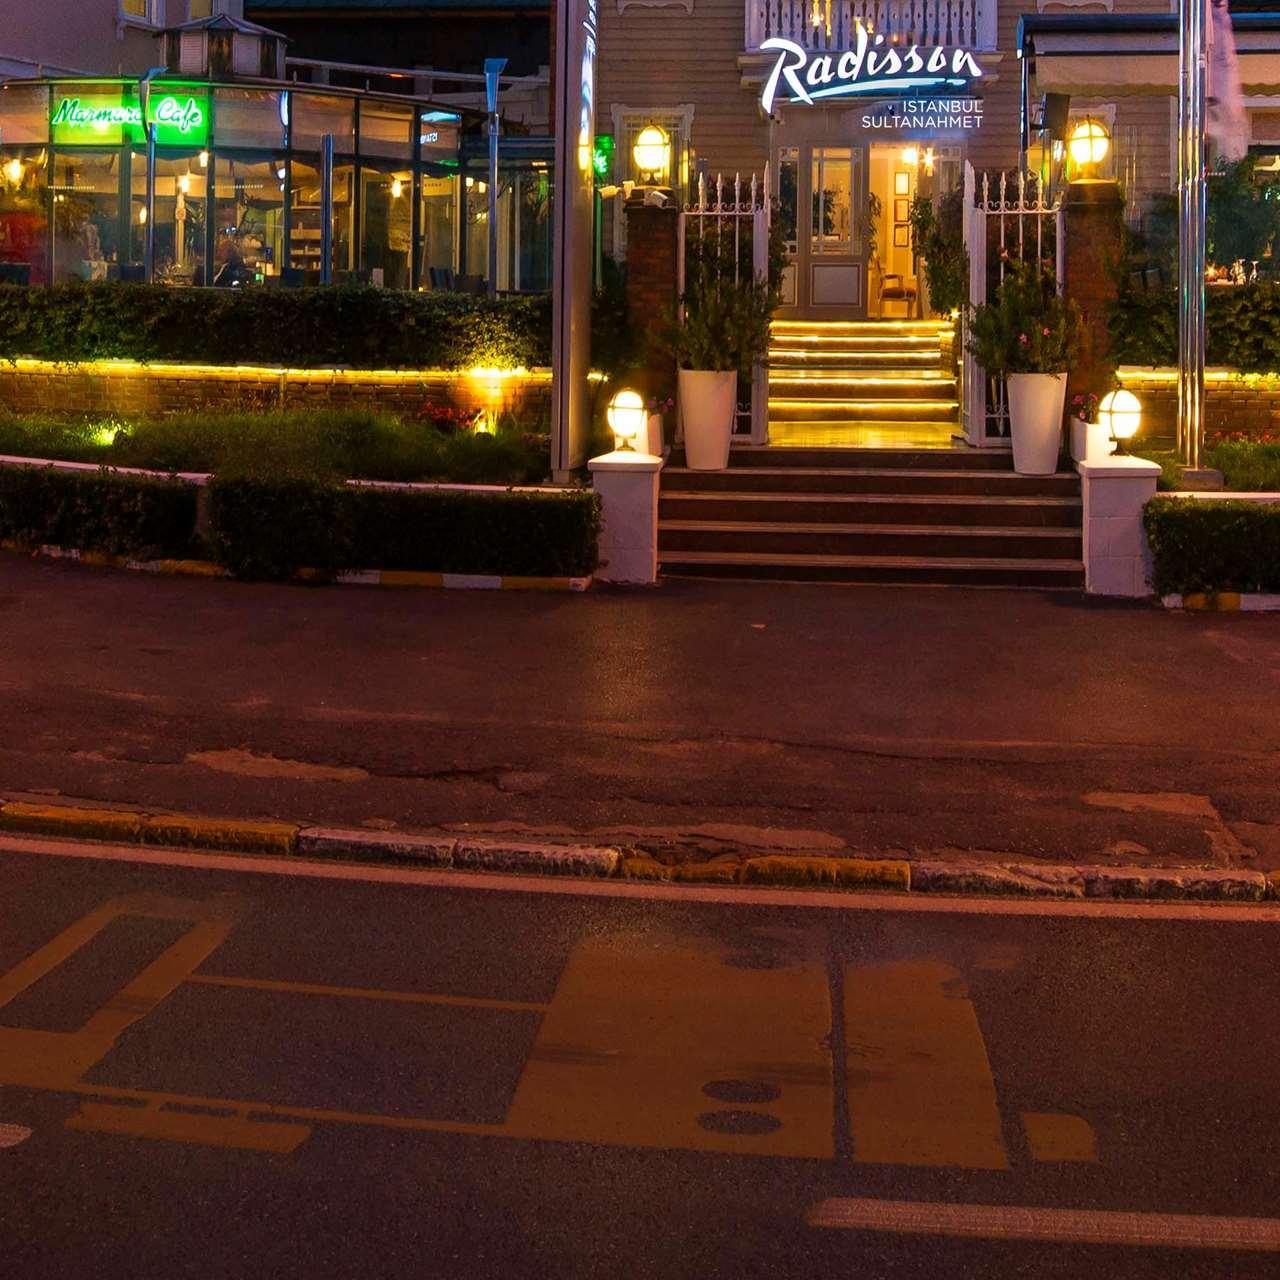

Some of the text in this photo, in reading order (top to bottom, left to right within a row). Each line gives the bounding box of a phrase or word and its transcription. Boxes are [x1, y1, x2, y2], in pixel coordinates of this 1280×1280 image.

[759, 21, 983, 114] Radisson
[156, 96, 203, 132] Cafe
[902, 100, 984, 114] ISTANBUL
[861, 115, 984, 129] SULTANAHMET
